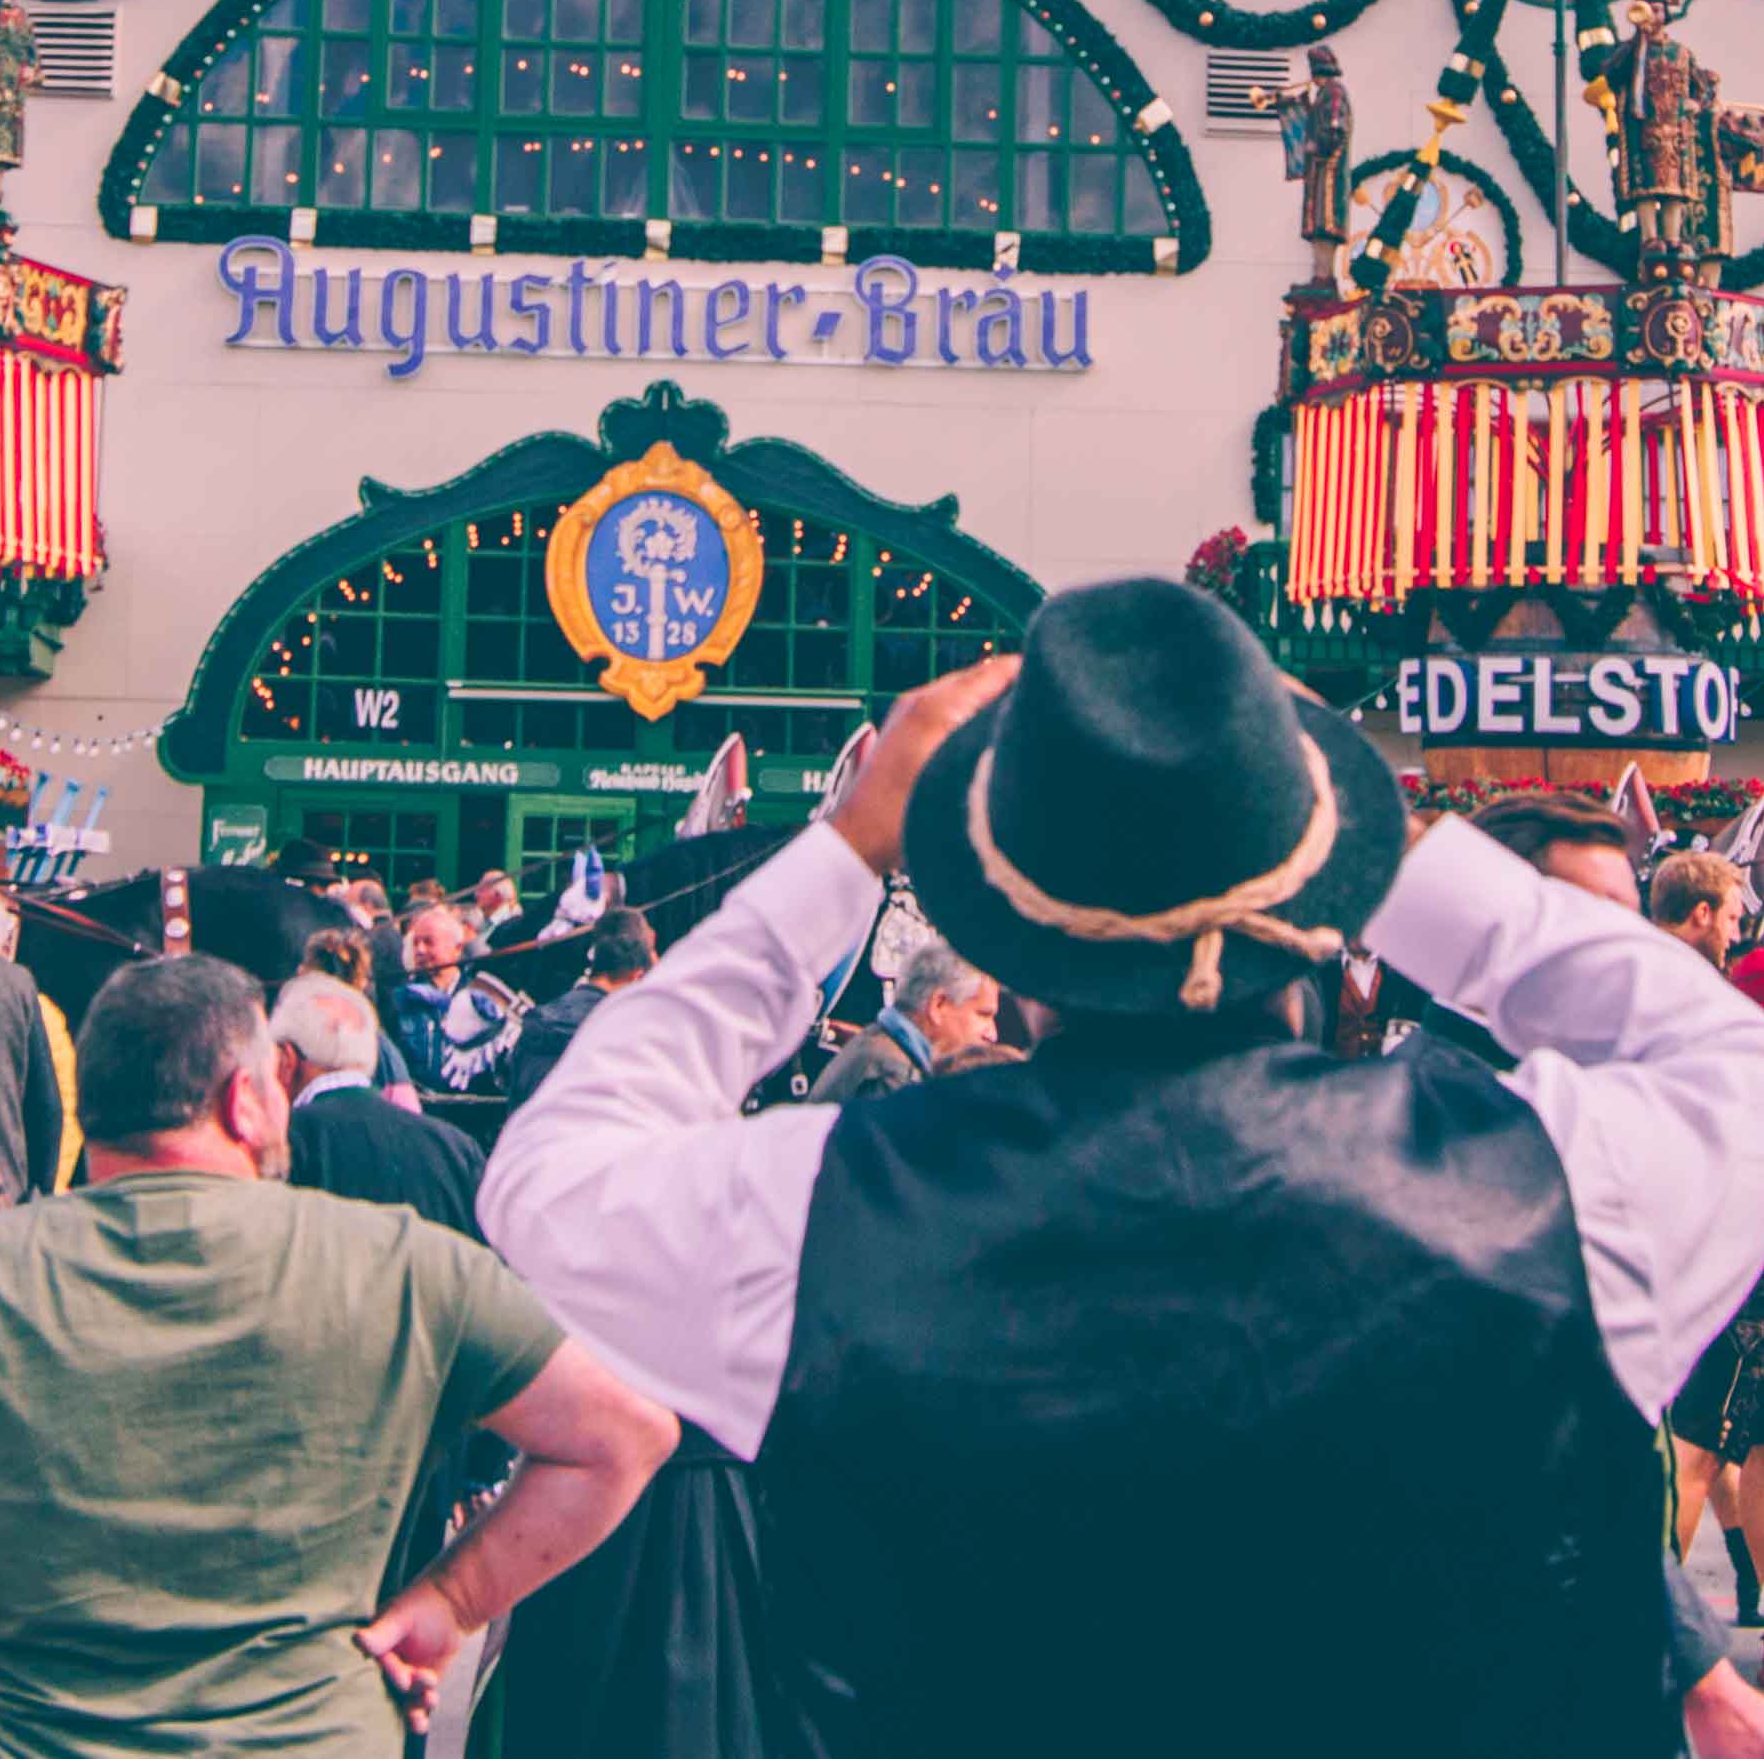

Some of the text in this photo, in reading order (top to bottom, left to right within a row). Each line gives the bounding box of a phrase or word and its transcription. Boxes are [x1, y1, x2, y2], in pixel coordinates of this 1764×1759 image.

[611, 584, 714, 618] J. W.
[611, 621, 697, 645] 13 28
[354, 688, 400, 729] W2
[303, 757, 519, 784] HAUPTAUSGANG
